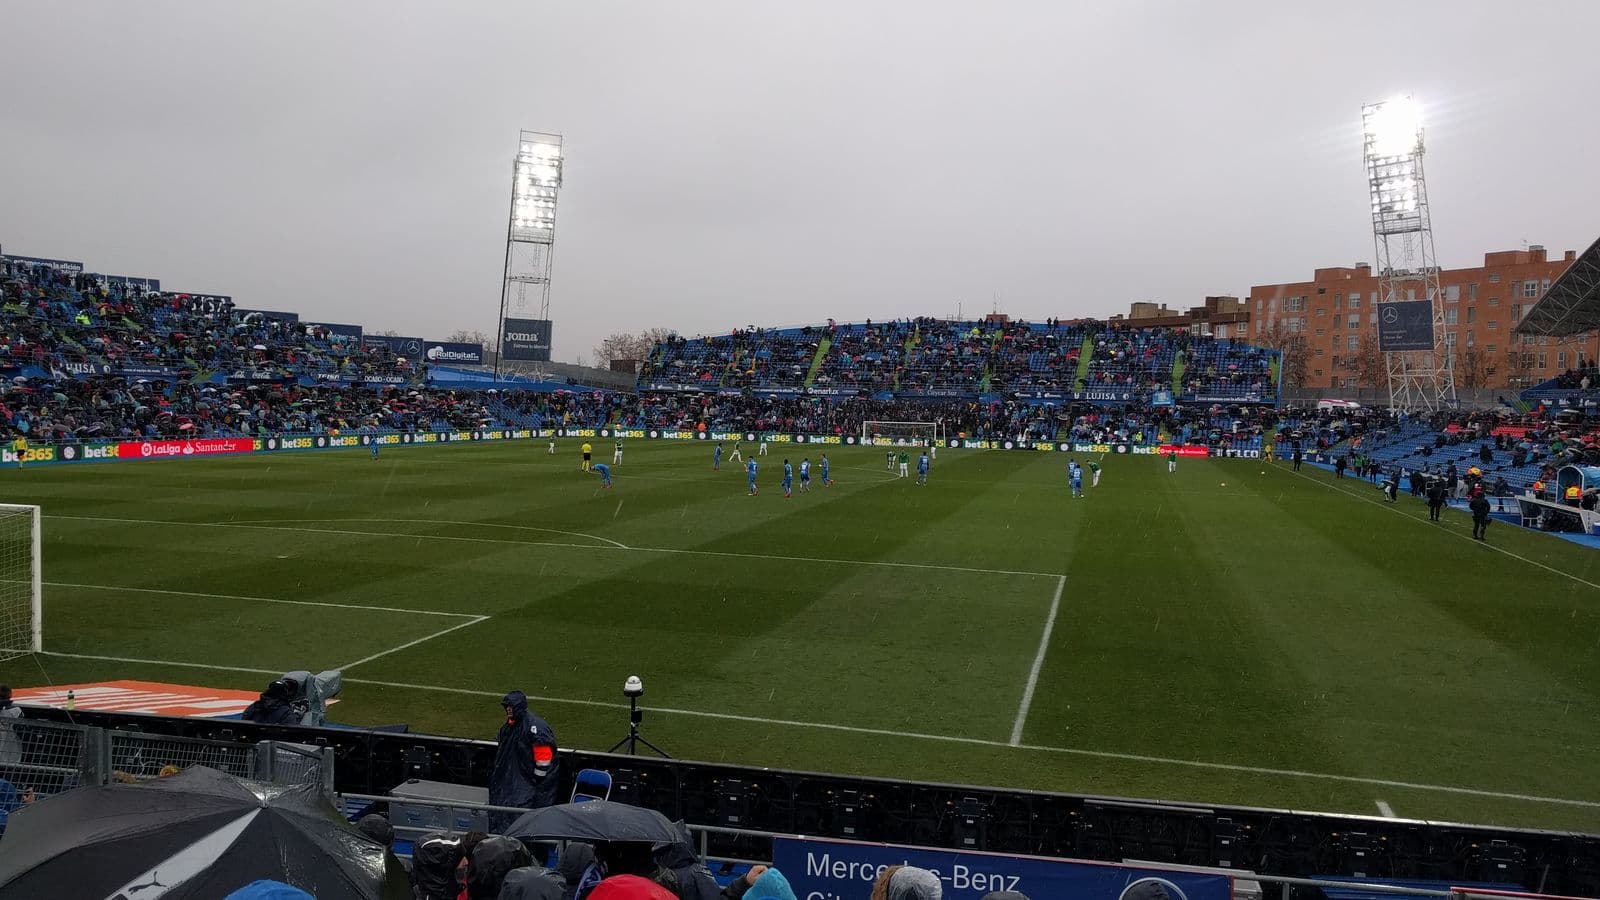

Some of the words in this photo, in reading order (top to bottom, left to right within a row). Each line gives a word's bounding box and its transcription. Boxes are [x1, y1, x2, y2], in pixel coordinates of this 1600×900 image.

[414, 433, 437, 442] bet365
[449, 432, 470, 441] bet365
[482, 431, 503, 440] bet365
[512, 430, 530, 438] bet365
[566, 429, 596, 437] bet365
[614, 430, 645, 438] bet365
[663, 431, 693, 439] bet365
[711, 432, 742, 440] bet365
[281, 438, 312, 449] bet365
[330, 436, 358, 447] bet365
[809, 434, 841, 444] bet365
[153, 443, 181, 456] LaLiga
[1075, 443, 1110, 453] bet365
